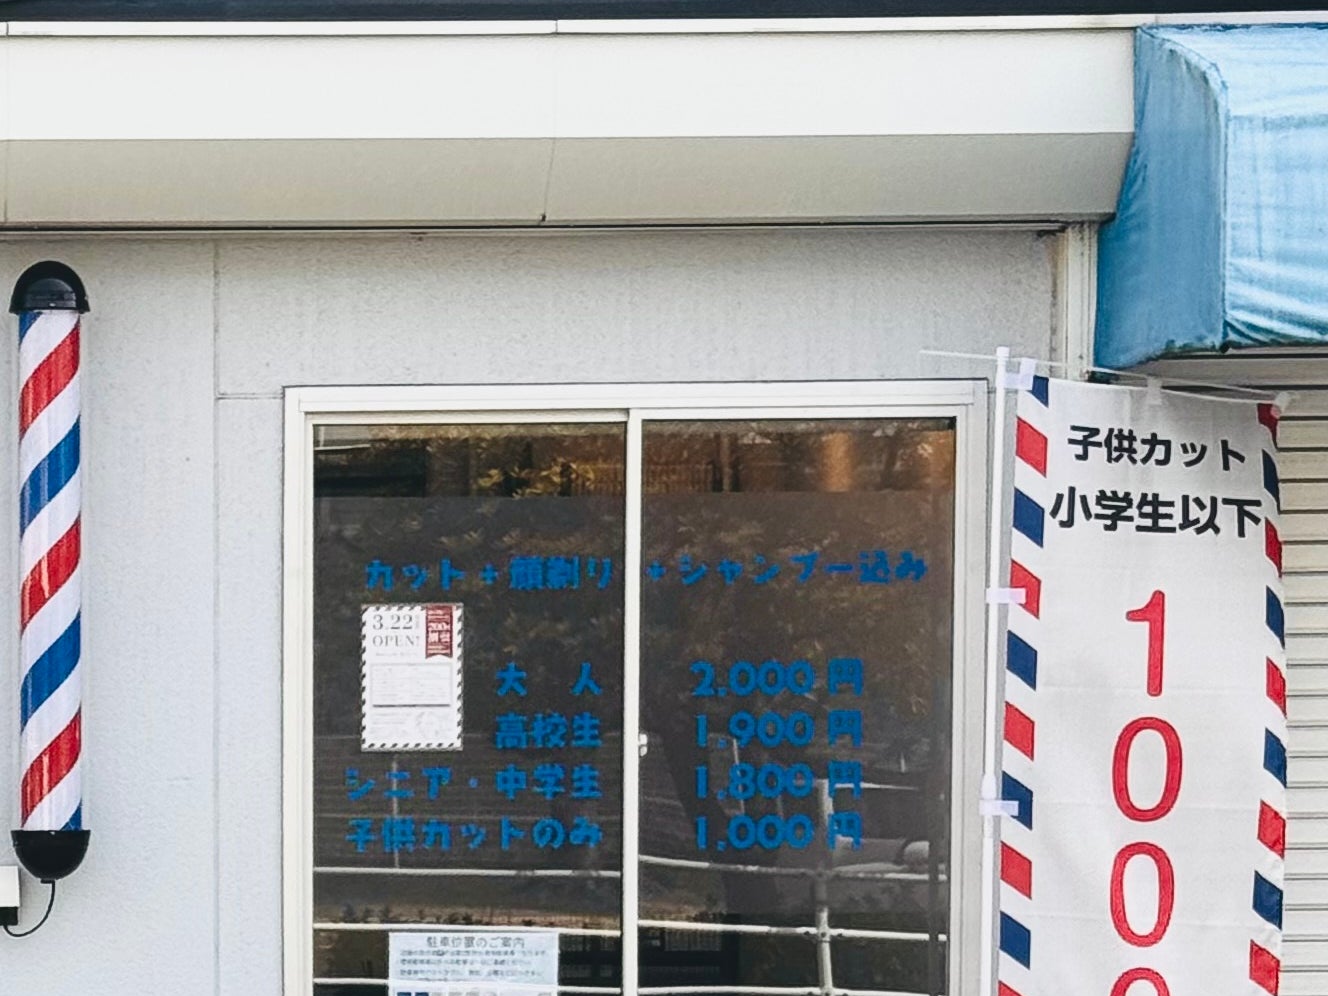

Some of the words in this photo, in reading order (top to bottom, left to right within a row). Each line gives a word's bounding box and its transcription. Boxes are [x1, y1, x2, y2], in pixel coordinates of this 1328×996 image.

[1067, 424, 1246, 471] 子供カット
[1049, 485, 1262, 538] 小学生以下
[495, 711, 603, 748] 高校生
[345, 815, 603, 852] 子供カットのみ
